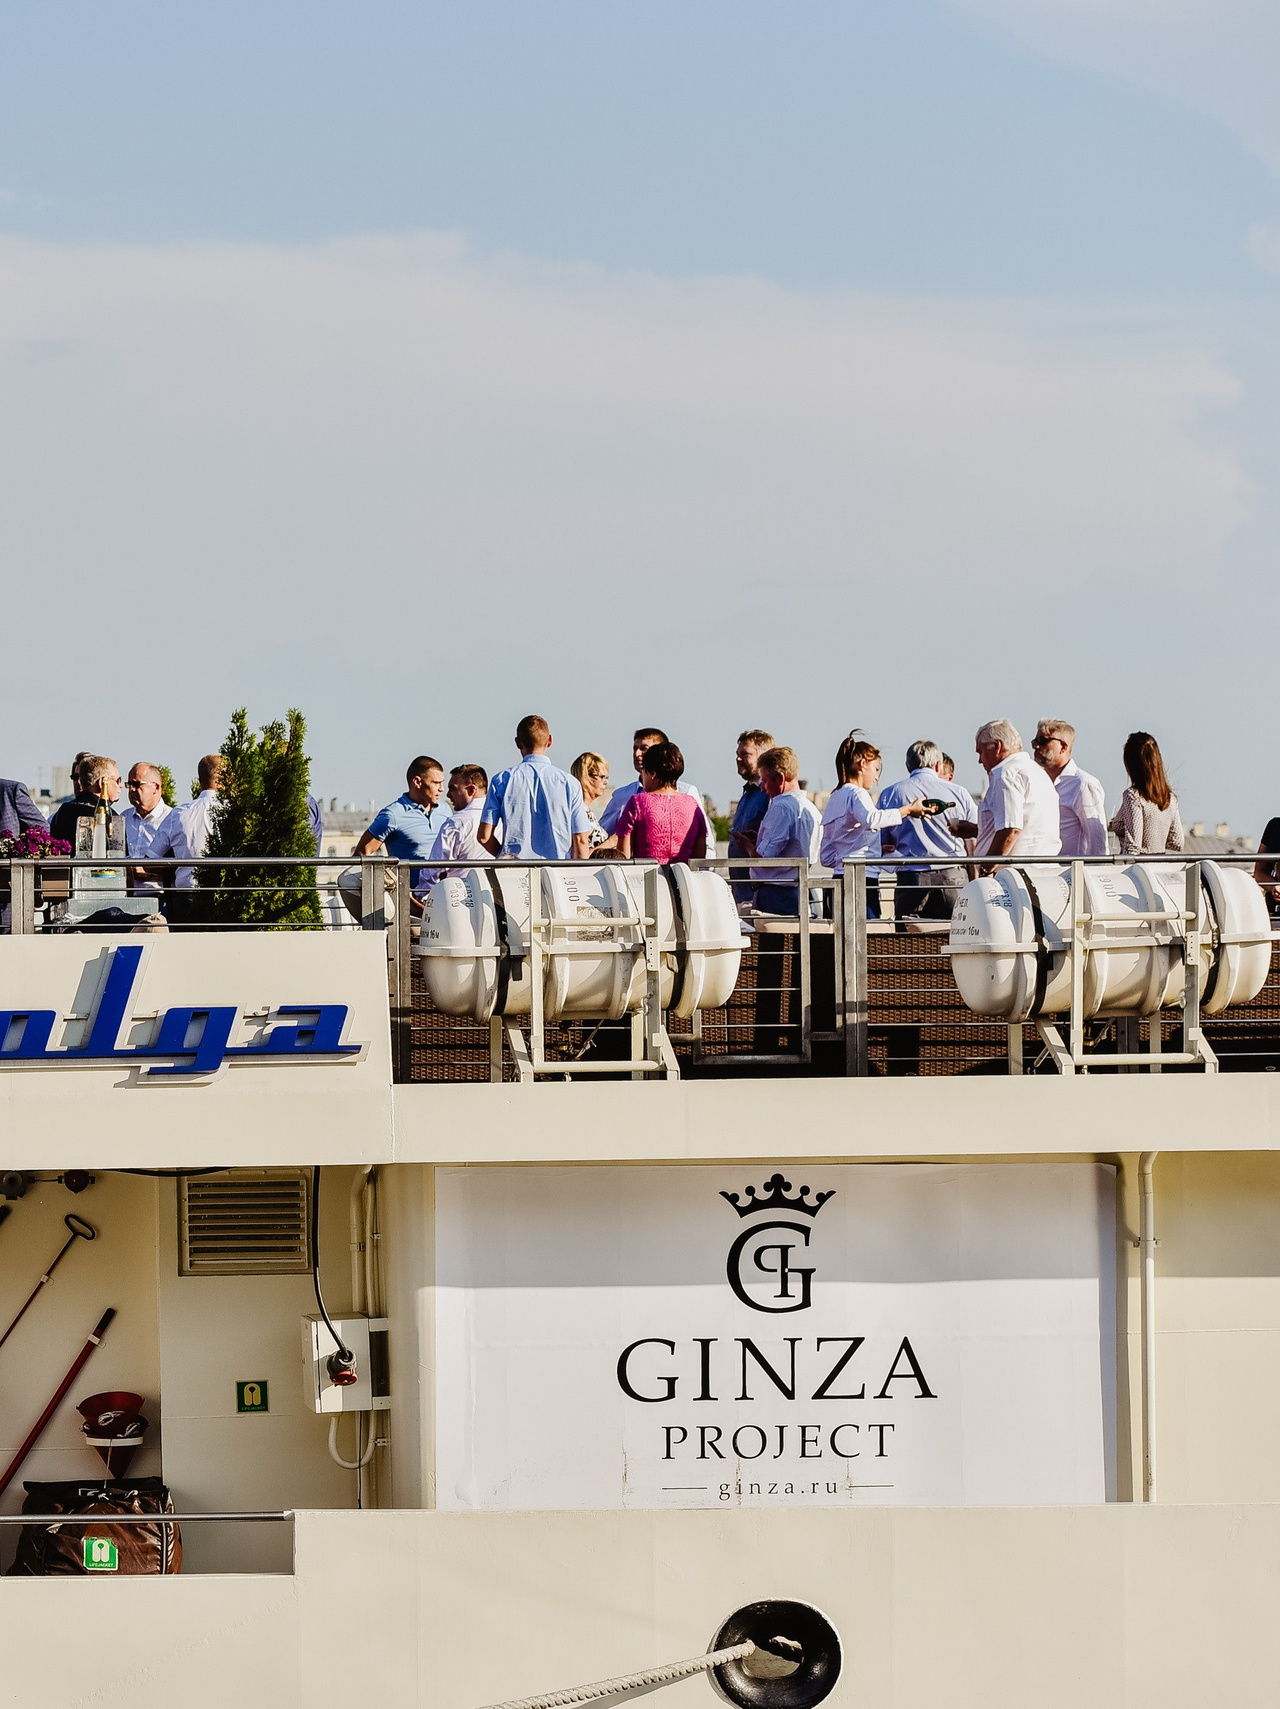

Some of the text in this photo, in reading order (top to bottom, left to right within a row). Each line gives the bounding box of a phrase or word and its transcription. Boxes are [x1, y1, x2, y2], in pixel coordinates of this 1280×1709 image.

[616, 1336, 939, 1403] GINZA
[661, 1423, 896, 1460] PROJECT
[719, 1478, 839, 1501] ginza.ru
